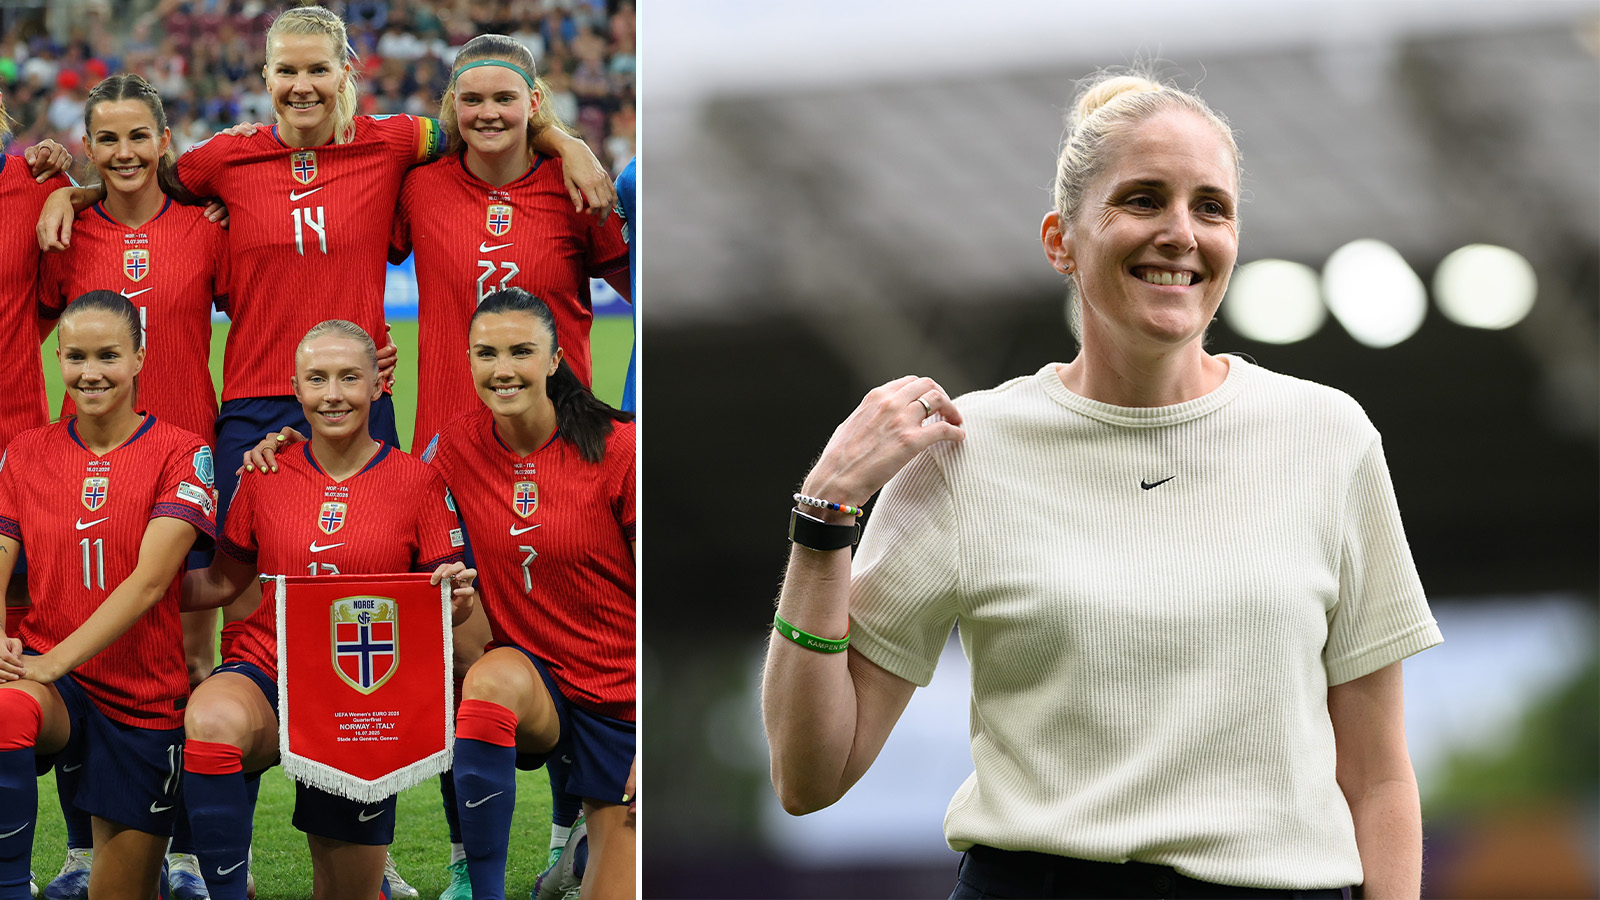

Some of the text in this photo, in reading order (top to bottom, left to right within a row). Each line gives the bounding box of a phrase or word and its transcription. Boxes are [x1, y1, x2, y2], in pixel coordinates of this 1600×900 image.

[290, 206, 327, 256] 14
[79, 538, 105, 591] 11
[518, 545, 538, 594] 7
[354, 600, 375, 609] NORGE
[808, 639, 838, 650] KAMPEN
[164, 744, 182, 796] 11
